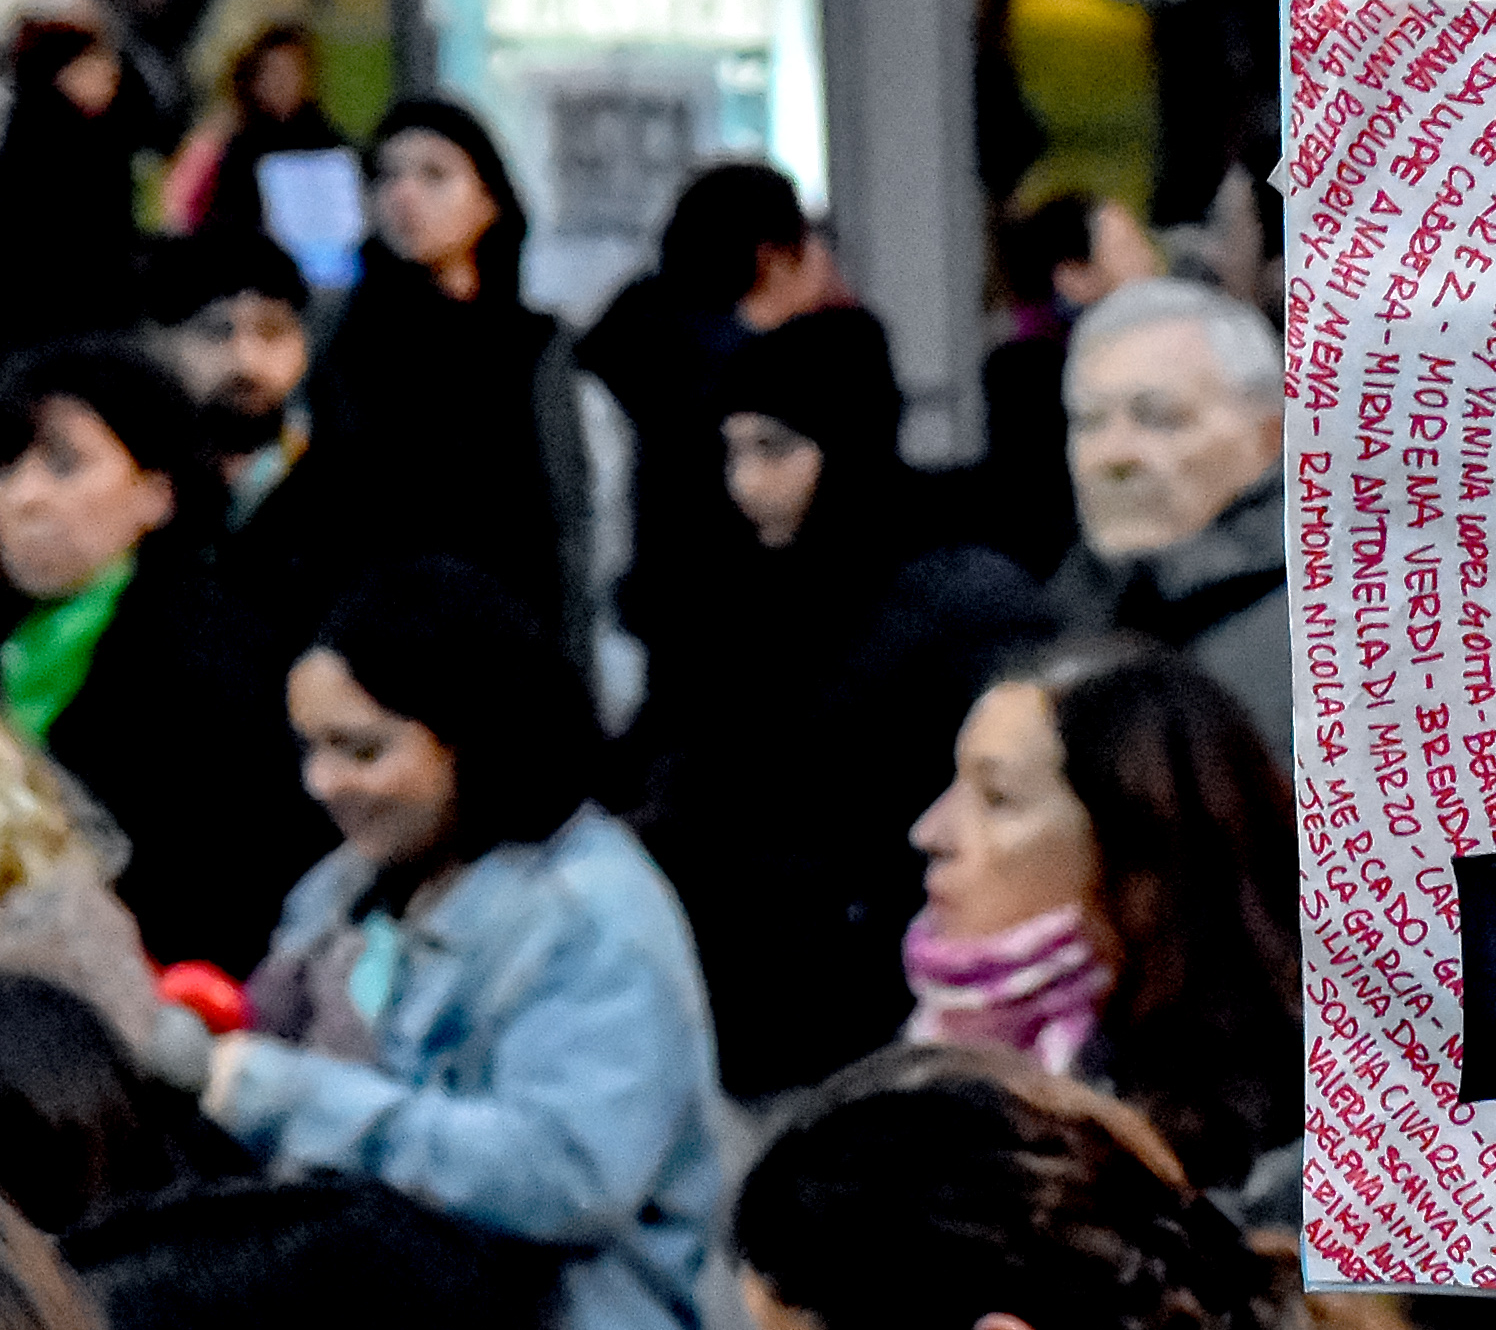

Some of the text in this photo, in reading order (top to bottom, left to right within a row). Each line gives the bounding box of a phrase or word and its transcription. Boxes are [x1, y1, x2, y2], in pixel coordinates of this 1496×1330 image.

[1306, 308, 1348, 410] MENA
[1358, 353, 1399, 460] MIRNA
[1404, 355, 1454, 528] MORENA
[1461, 388, 1496, 500] YANINA
[1300, 453, 1331, 590] RAMONA
[1405, 549, 1443, 663] VERDI
[1305, 604, 1345, 763] NICOLASA
[1362, 675, 1392, 708] DI
[1370, 725, 1421, 835] MARZO
[1301, 782, 1431, 1016] JESICA GARCIA
[1330, 780, 1426, 945] MERCADO
[1299, 890, 1390, 1016] SILVINA
[1308, 977, 1491, 1224] SOPHIA CIVARELLI
[1309, 1038, 1471, 1262] VALERIA SCHWAB
